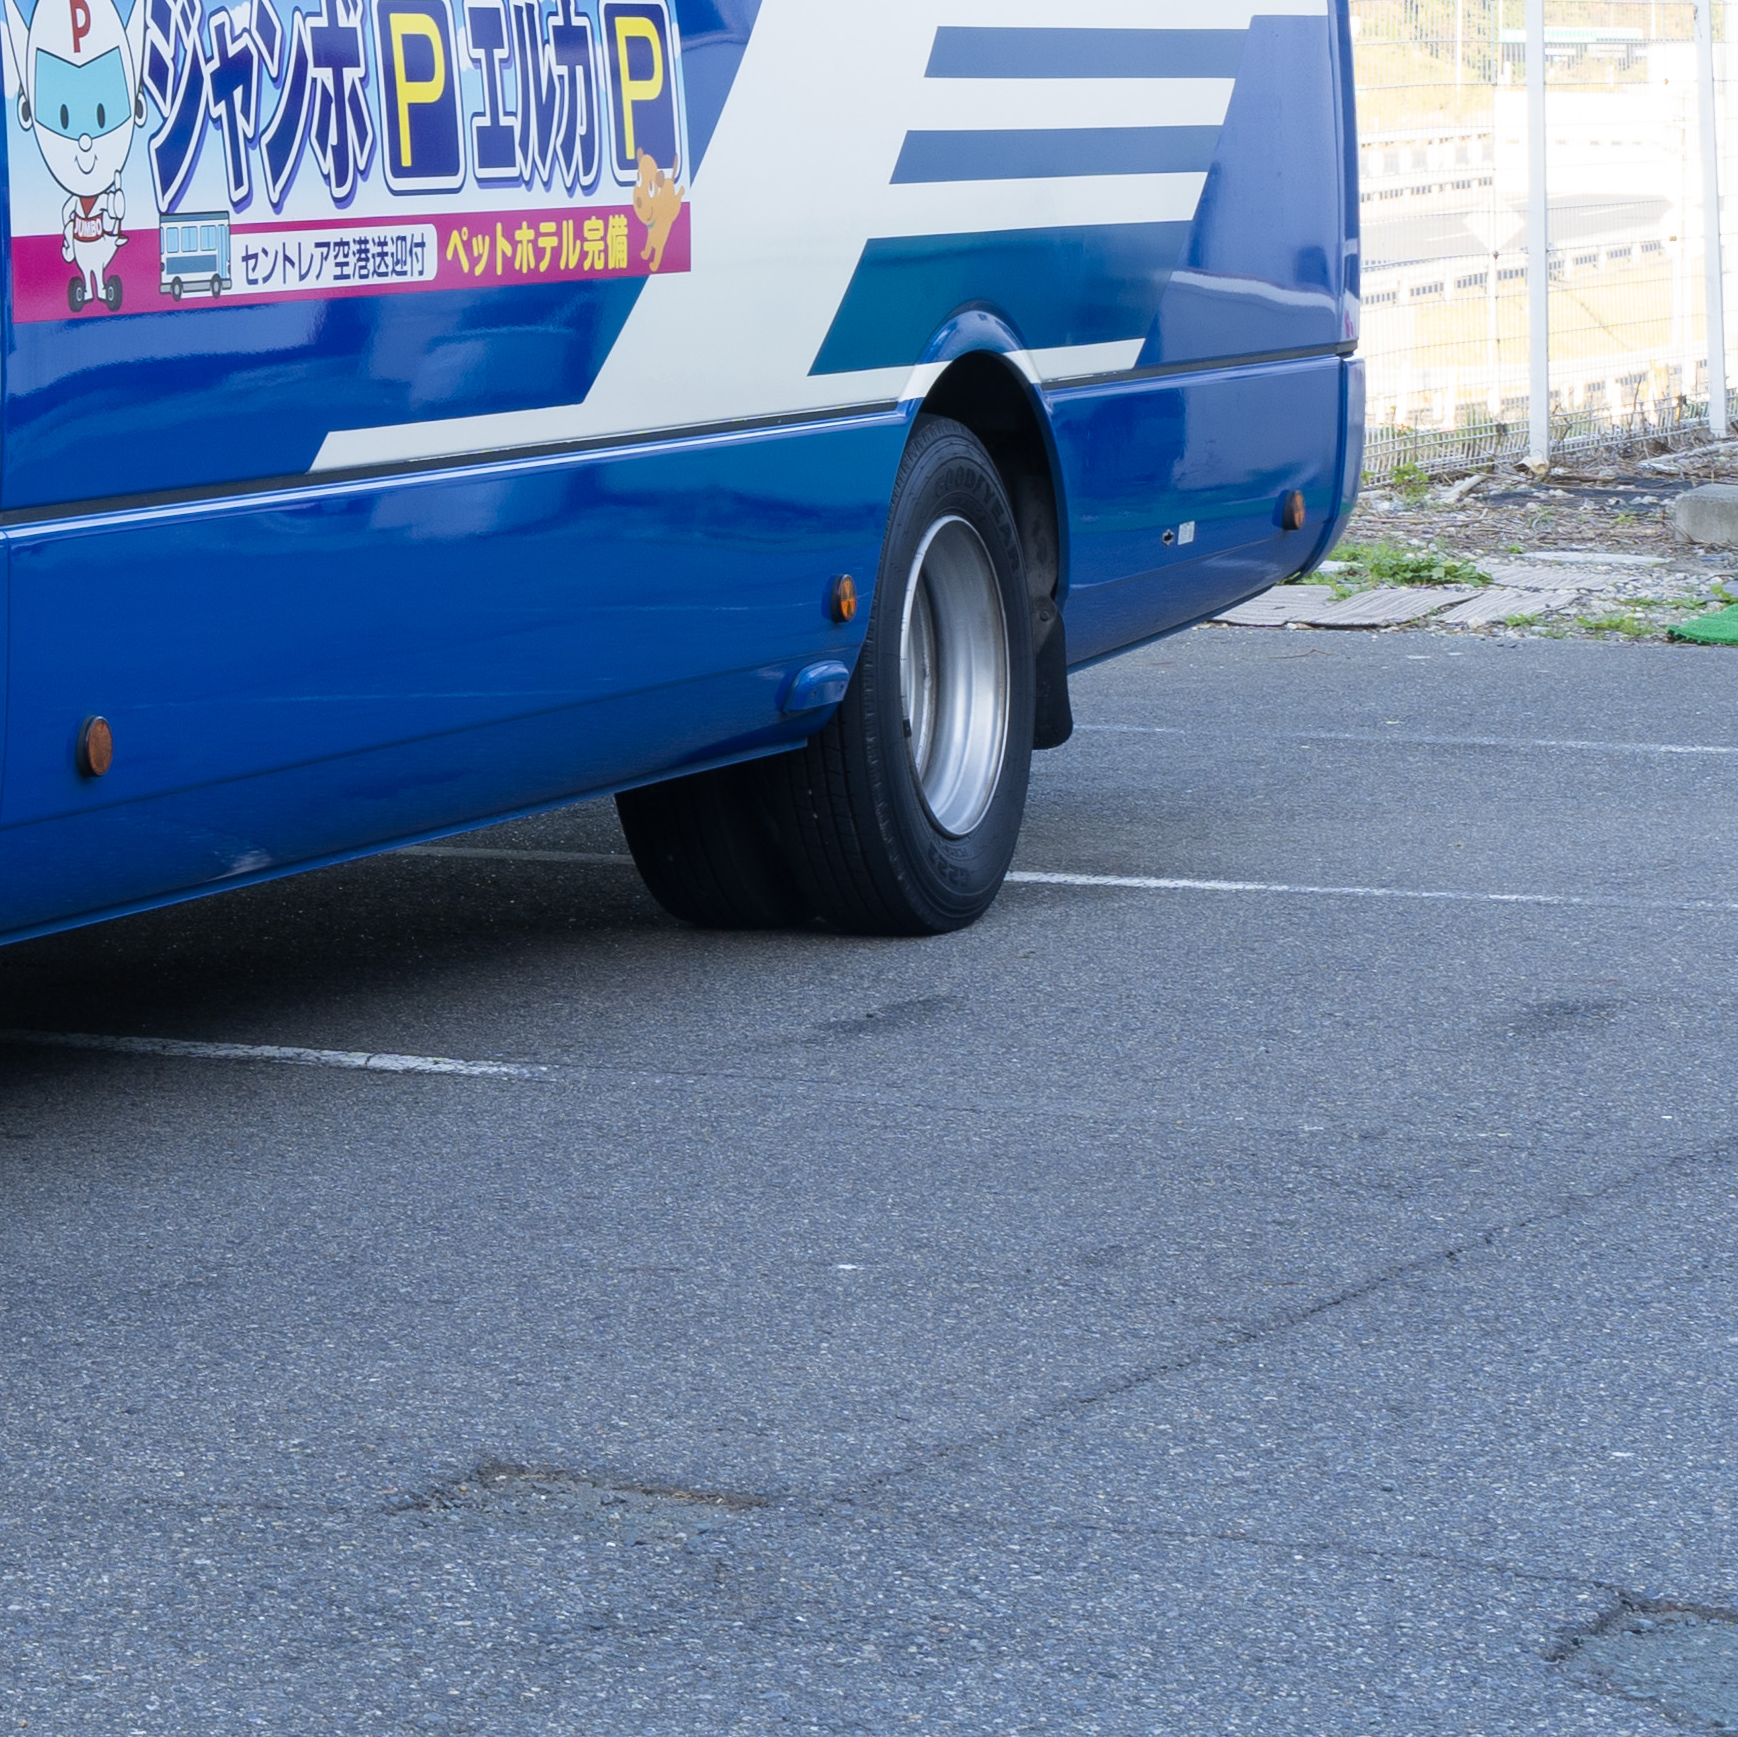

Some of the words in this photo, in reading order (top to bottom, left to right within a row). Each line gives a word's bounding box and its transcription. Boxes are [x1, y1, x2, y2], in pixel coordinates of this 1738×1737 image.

[74, 217, 103, 238] JUMBO
[240, 232, 427, 287] セントレア空港送迎付
[445, 214, 628, 276] ペットホテル完備
